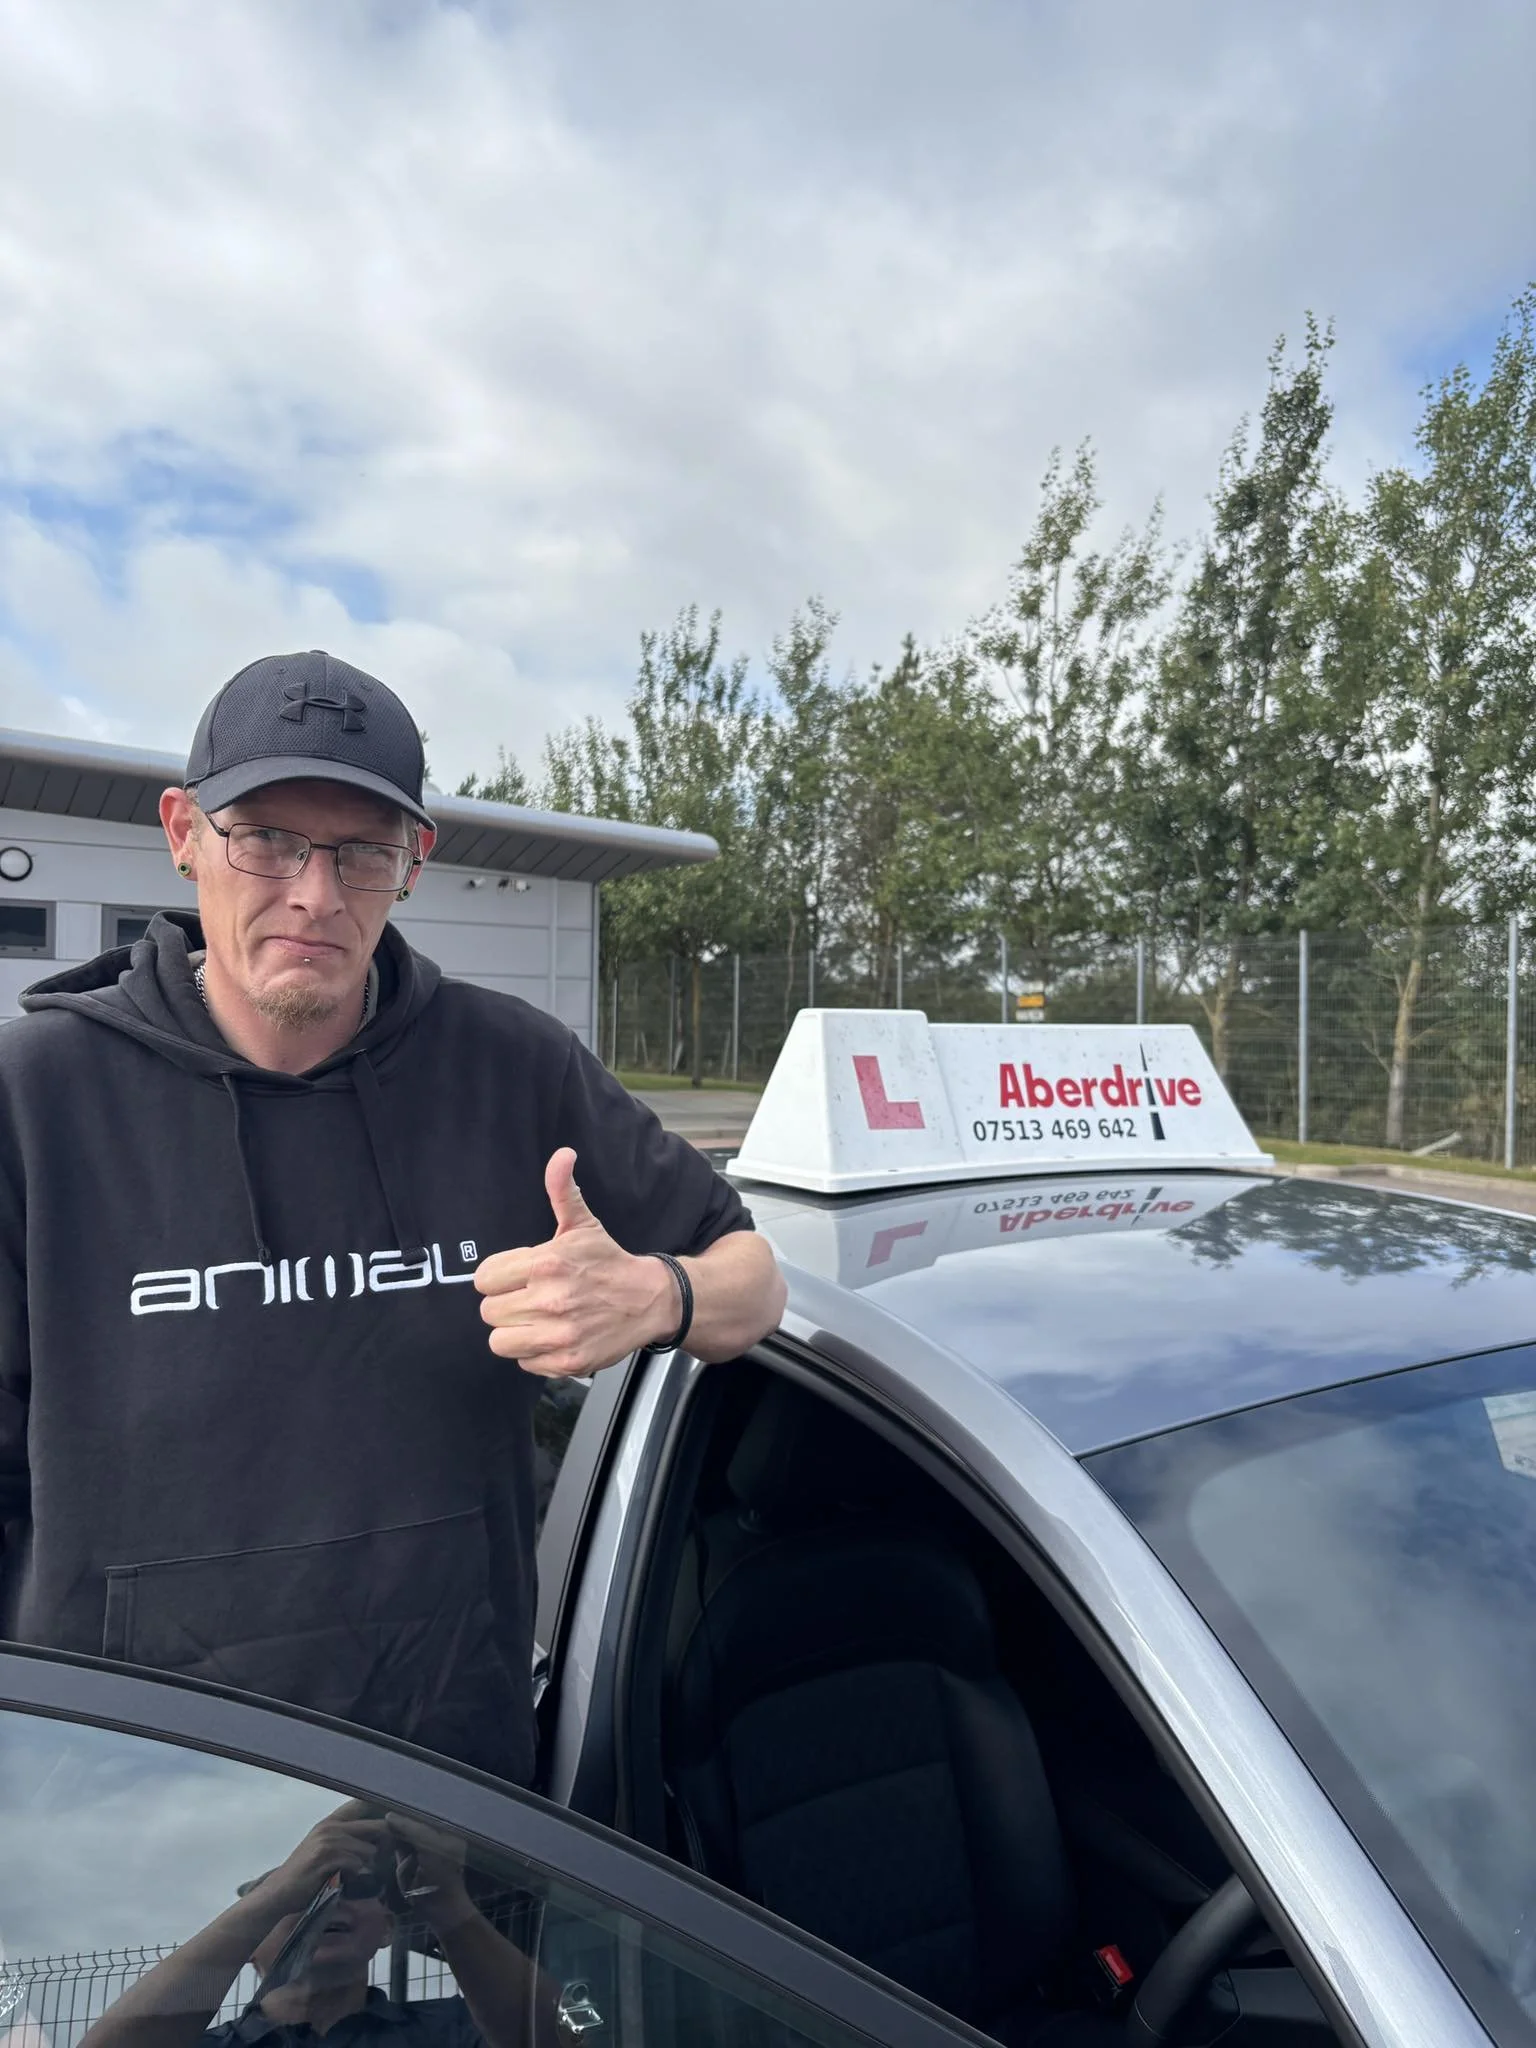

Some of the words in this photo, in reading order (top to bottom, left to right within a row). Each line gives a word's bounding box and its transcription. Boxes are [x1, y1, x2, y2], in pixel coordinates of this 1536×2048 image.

[852, 1055, 926, 1129] L
[999, 1043, 1202, 1108] Aberdrive
[973, 1119, 1043, 1141] 07513
[1051, 1118, 1091, 1140] 469
[1097, 1117, 1137, 1138] 642
